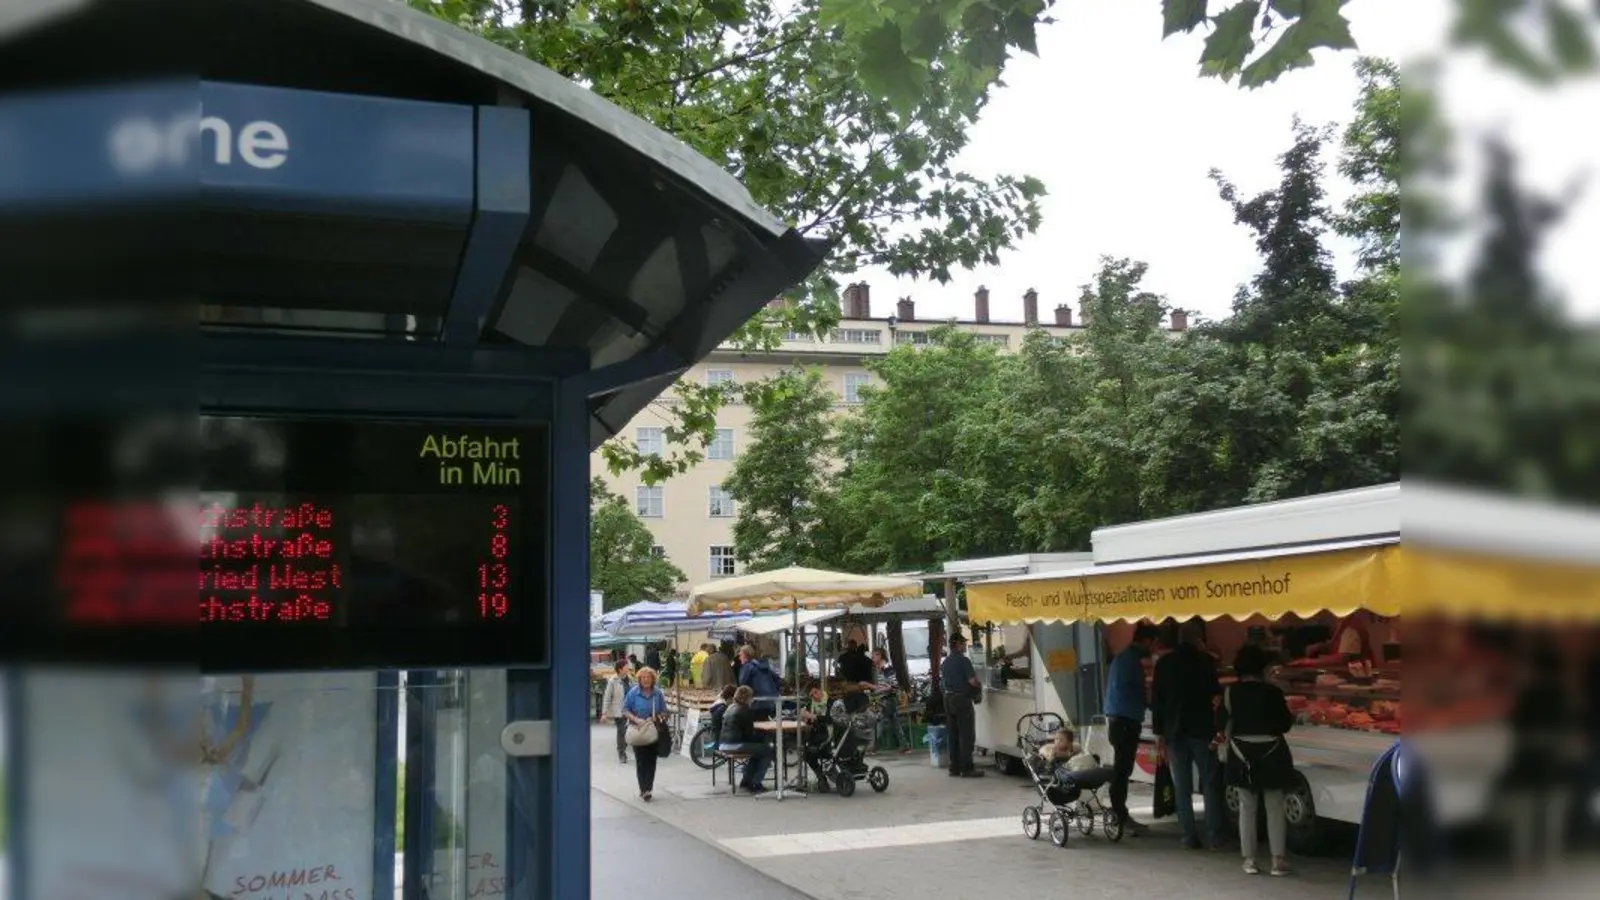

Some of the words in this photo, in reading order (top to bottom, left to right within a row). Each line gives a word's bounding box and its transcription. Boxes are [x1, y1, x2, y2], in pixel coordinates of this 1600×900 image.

[419, 434, 520, 459] Abfahrt
[439, 461, 463, 485] in
[472, 462, 521, 486] Min
[492, 504, 508, 528] 3
[492, 534, 508, 557] 8
[269, 564, 342, 589] West
[479, 563, 509, 588] 13
[1041, 590, 1061, 607] und
[1170, 584, 1200, 601] vom
[1206, 572, 1292, 599] Sonnenhof
[478, 593, 508, 618] 19
[232, 864, 342, 895] SOMMER
